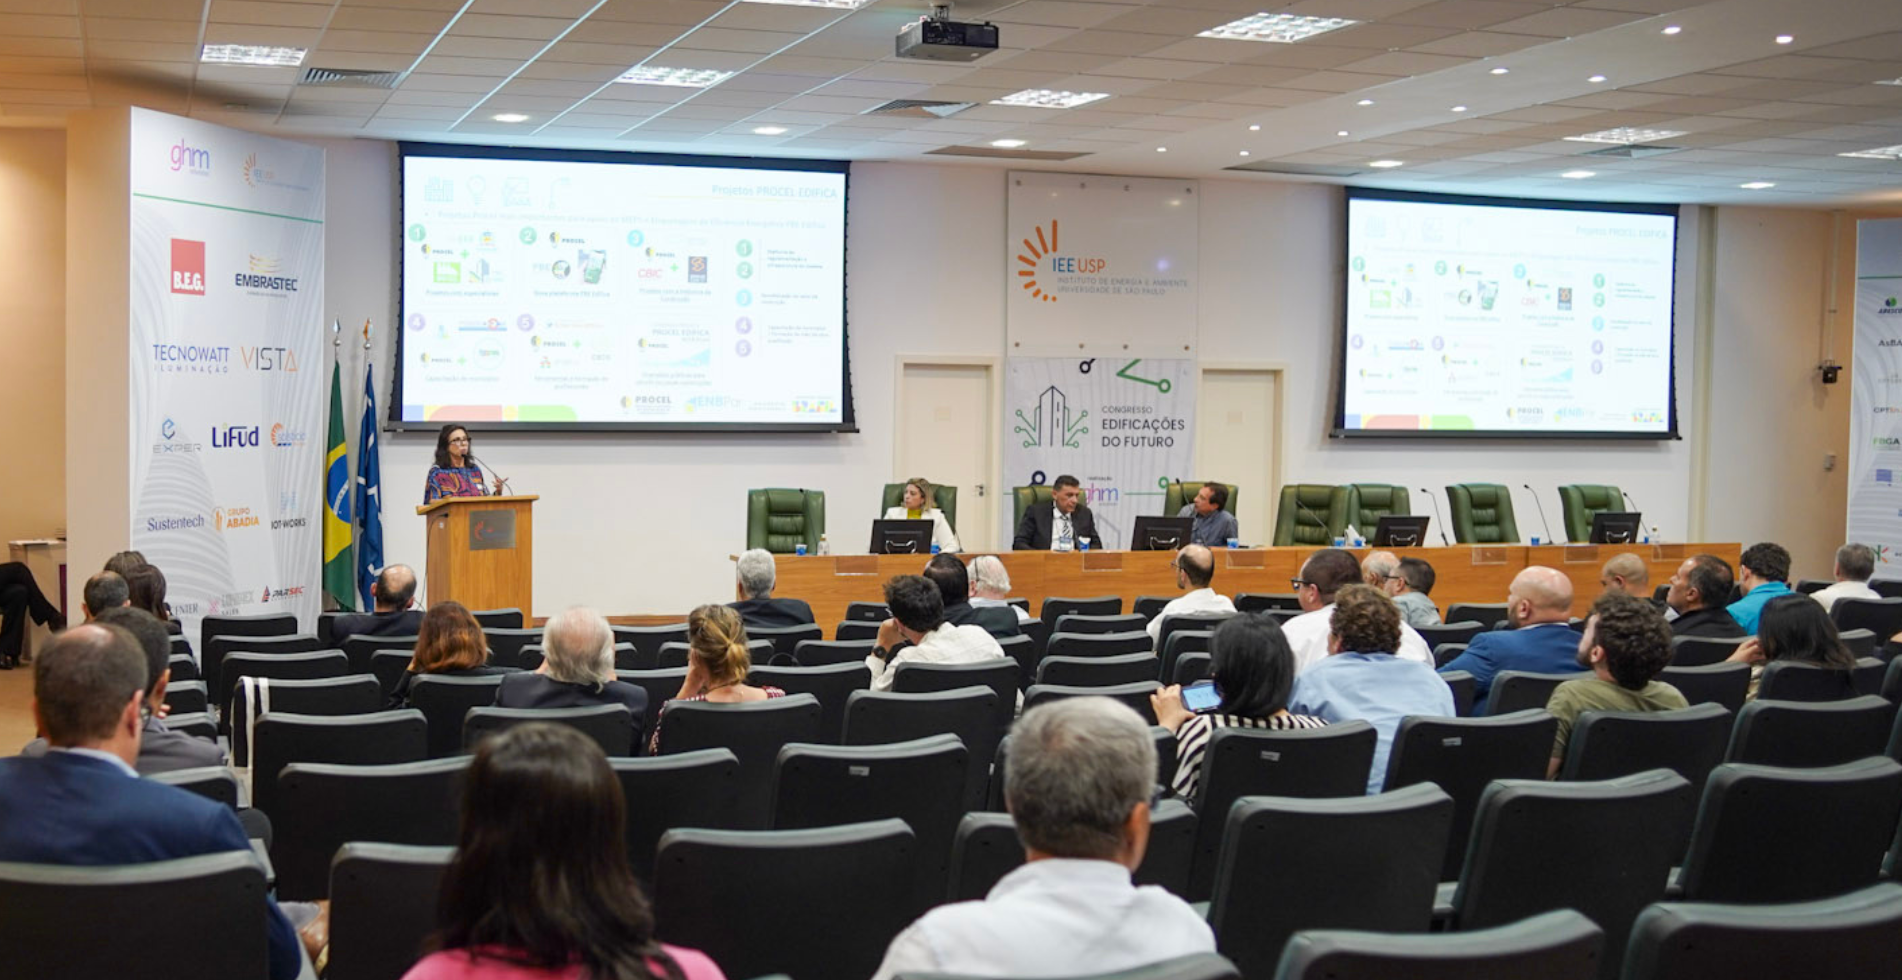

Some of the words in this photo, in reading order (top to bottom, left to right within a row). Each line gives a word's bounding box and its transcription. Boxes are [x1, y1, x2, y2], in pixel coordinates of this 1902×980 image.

[170, 138, 210, 171] ghm
[712, 184, 754, 197] Projetos
[756, 186, 795, 198] PROCEL
[798, 187, 838, 199] EDIFICA
[1053, 257, 1075, 273] IEE
[1078, 258, 1106, 274] USP
[173, 271, 205, 291] B.E.G.
[235, 273, 298, 291] EMBRASTEC
[1058, 276, 1097, 285] INSTITUTO
[1099, 277, 1108, 285] DE
[1111, 278, 1142, 286] ENERGIA
[1152, 279, 1188, 288] AMBIENTE
[1057, 285, 1114, 294] UNIVERSIDADE
[1116, 286, 1123, 294] DE
[1125, 285, 1140, 295] SÃO
[1142, 287, 1166, 295] PAULO
[153, 344, 230, 363] TECNOWATT
[241, 346, 298, 372] VISTA
[154, 363, 228, 374] ILUMINAÇÃO
[635, 395, 672, 404] PROCEL
[1102, 405, 1153, 414] CONGRESSO
[1102, 416, 1185, 434] EDIFICAÇÕES
[153, 443, 202, 454] EXPER
[1102, 436, 1121, 447] DO
[1124, 436, 1174, 448] FUTURO
[227, 507, 250, 517] GRUPO
[147, 514, 205, 532] Sustentech
[226, 516, 260, 529] ABADIA
